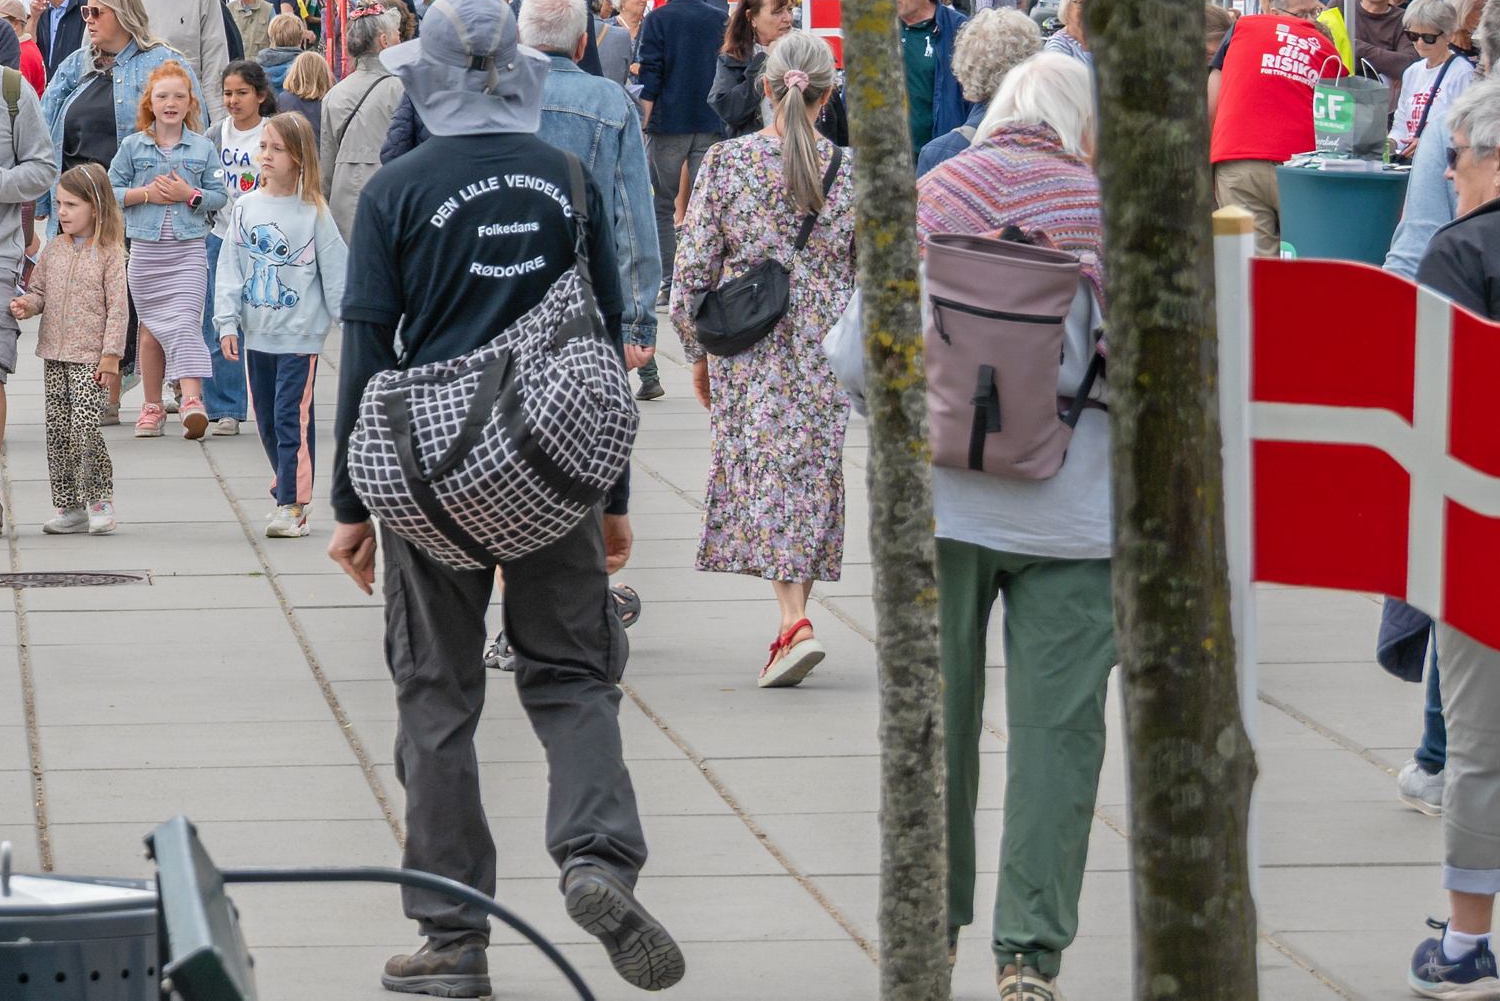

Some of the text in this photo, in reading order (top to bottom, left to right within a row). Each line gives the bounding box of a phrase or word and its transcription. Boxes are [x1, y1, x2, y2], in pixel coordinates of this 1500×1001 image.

[1275, 31, 1318, 55] TEST
[1279, 45, 1310, 64] din
[1261, 53, 1319, 83] RISIKO
[1313, 91, 1345, 120] GF
[430, 197, 460, 228] DEN
[459, 176, 500, 201] LILLE
[478, 221, 540, 237] Folkedans
[469, 255, 546, 278] RØDOVRE
